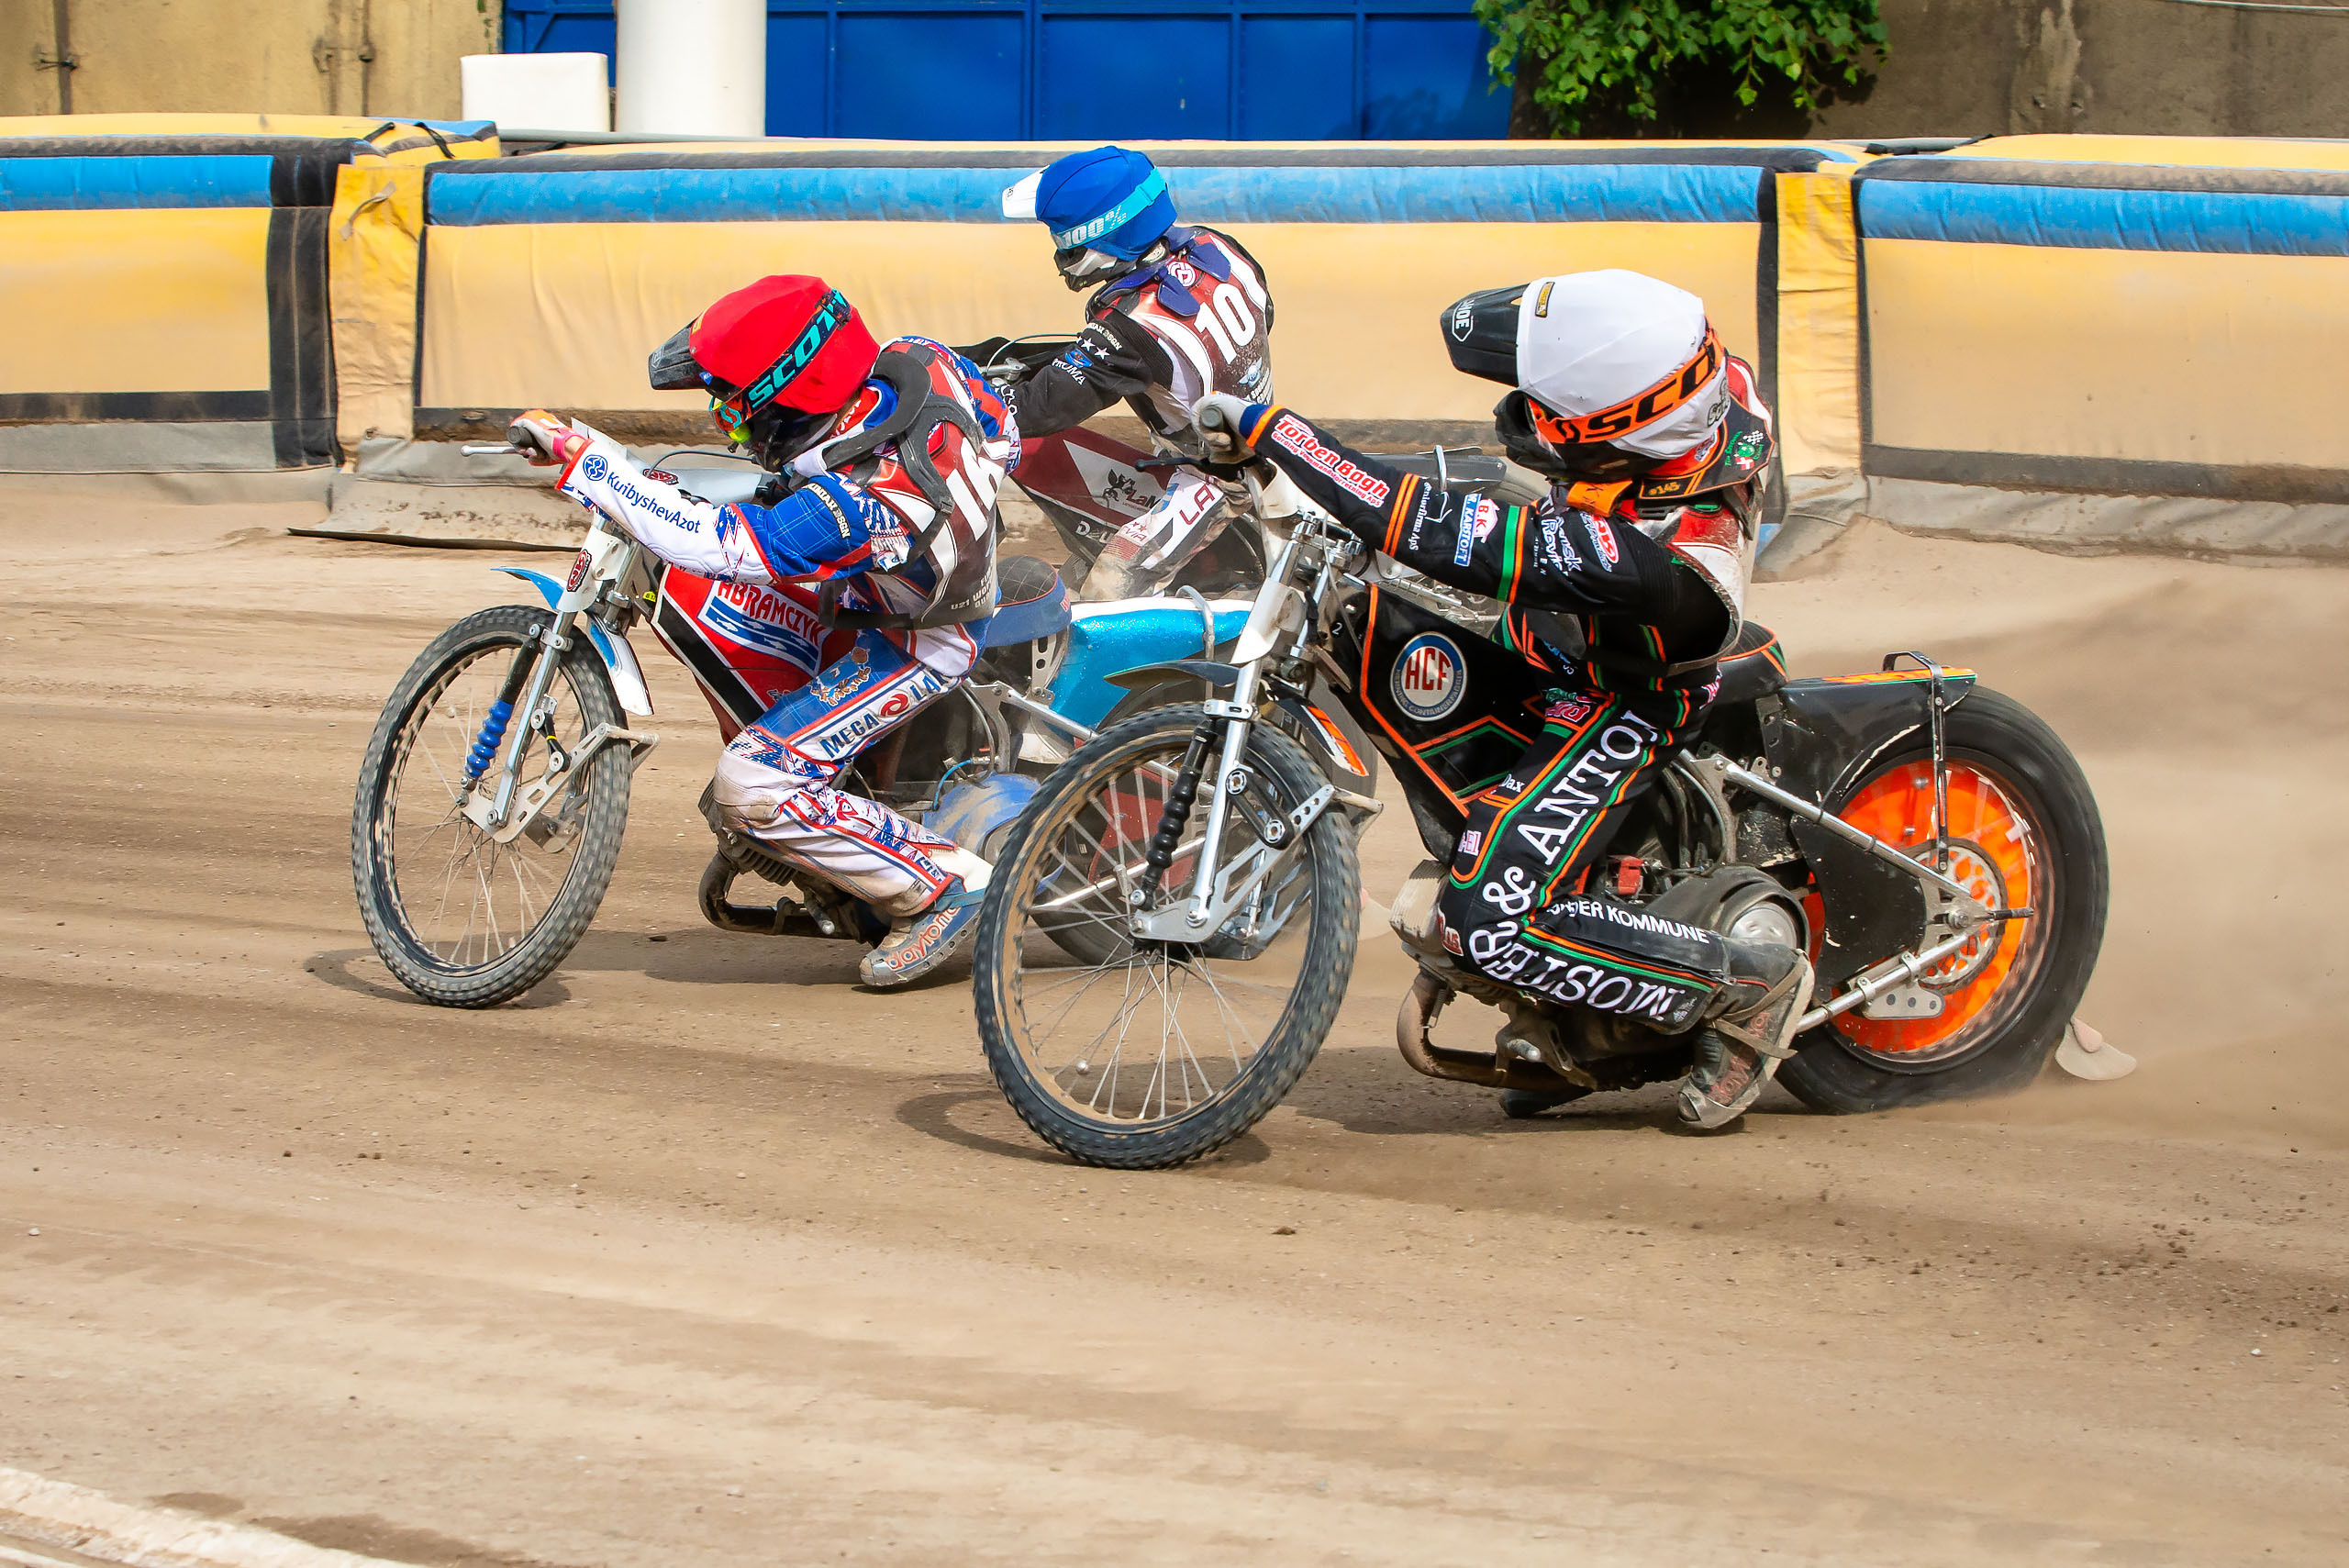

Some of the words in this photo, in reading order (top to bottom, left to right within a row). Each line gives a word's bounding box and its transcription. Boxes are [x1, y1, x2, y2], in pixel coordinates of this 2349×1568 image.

[1062, 205, 1127, 250] 100%
[1194, 284, 1256, 365] 10
[1275, 419, 1340, 466] Torben
[607, 472, 701, 534] KuibyshevAzot
[1458, 507, 1475, 562] KARSTOFT
[718, 581, 823, 644] ABRAMCZYK
[1405, 647, 1452, 690] HCF
[818, 713, 880, 760] MEGA
[1483, 866, 1537, 916] &
[1607, 905, 1710, 944] KOMMUNE
